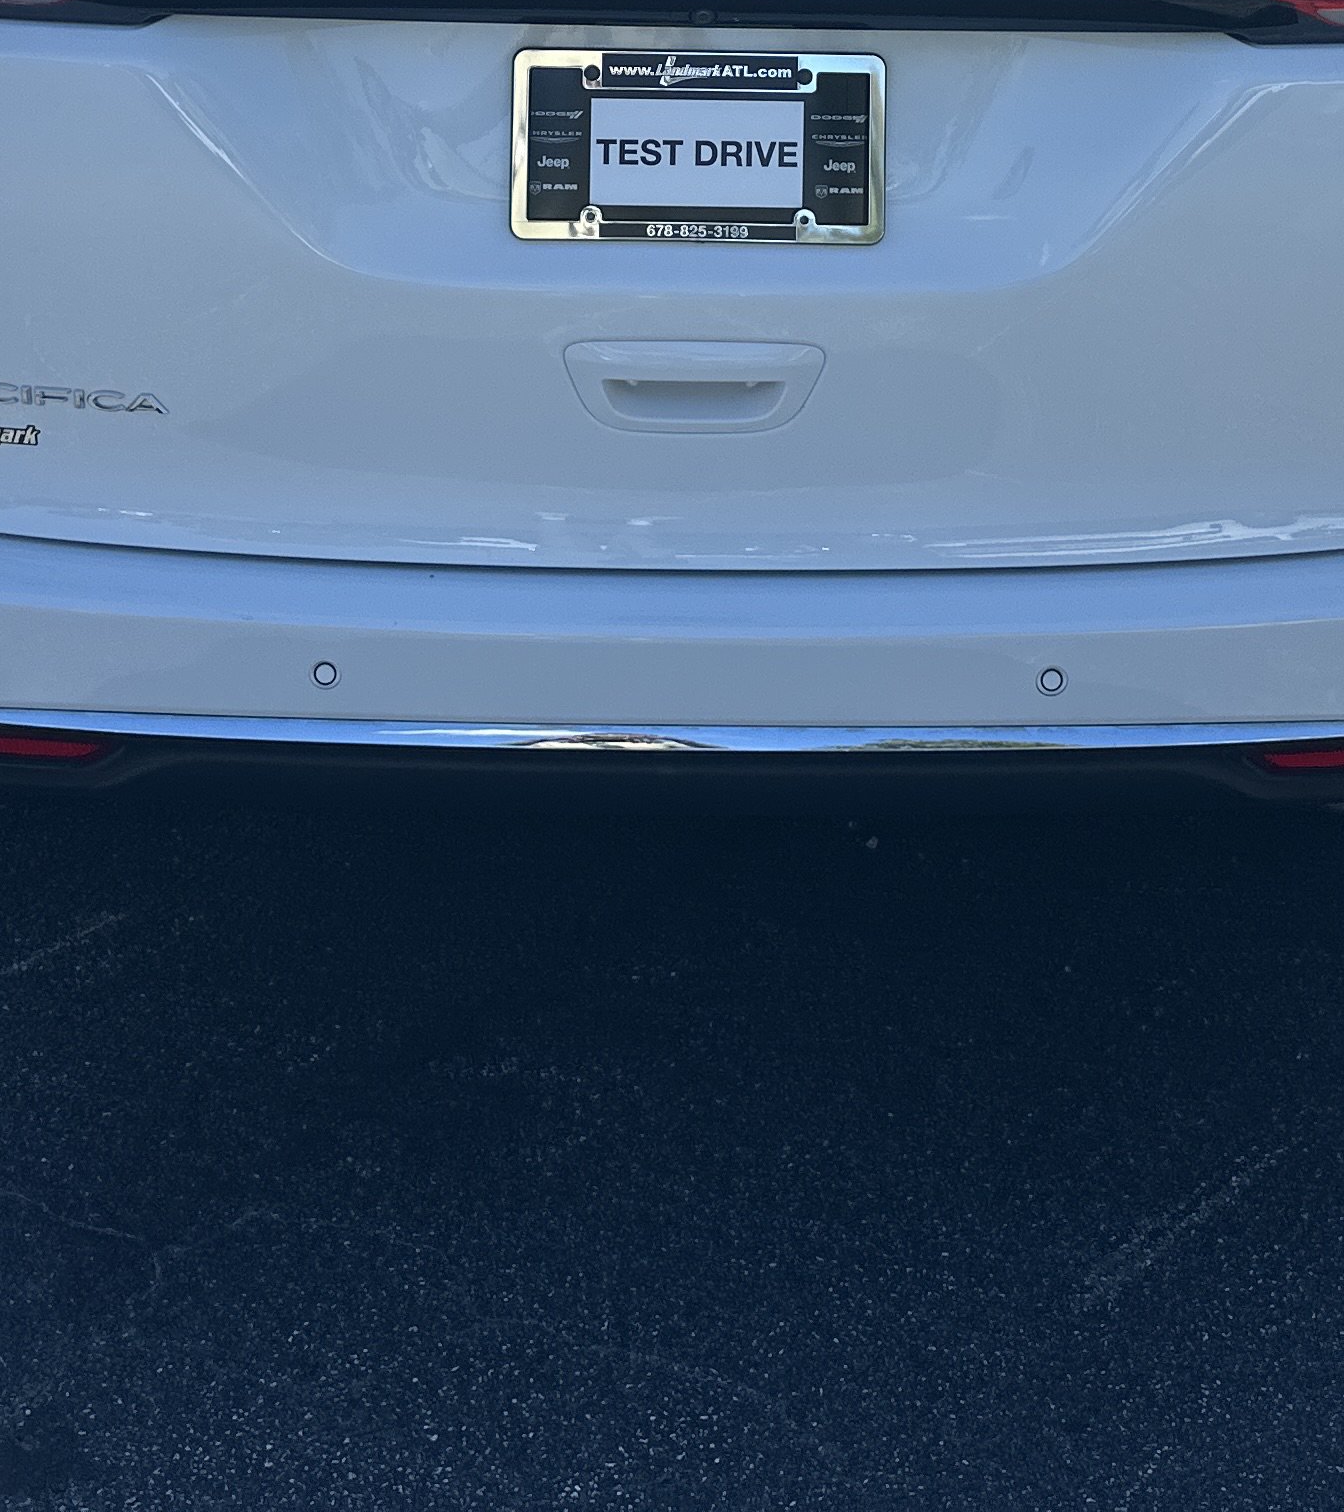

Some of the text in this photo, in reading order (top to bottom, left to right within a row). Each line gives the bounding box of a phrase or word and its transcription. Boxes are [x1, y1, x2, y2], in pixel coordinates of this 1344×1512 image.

[596, 139, 798, 167] TEST DRIVE
[537, 155, 570, 169] Jeep
[823, 159, 856, 173] Jeep
[646, 224, 749, 238] 678-825-3199
